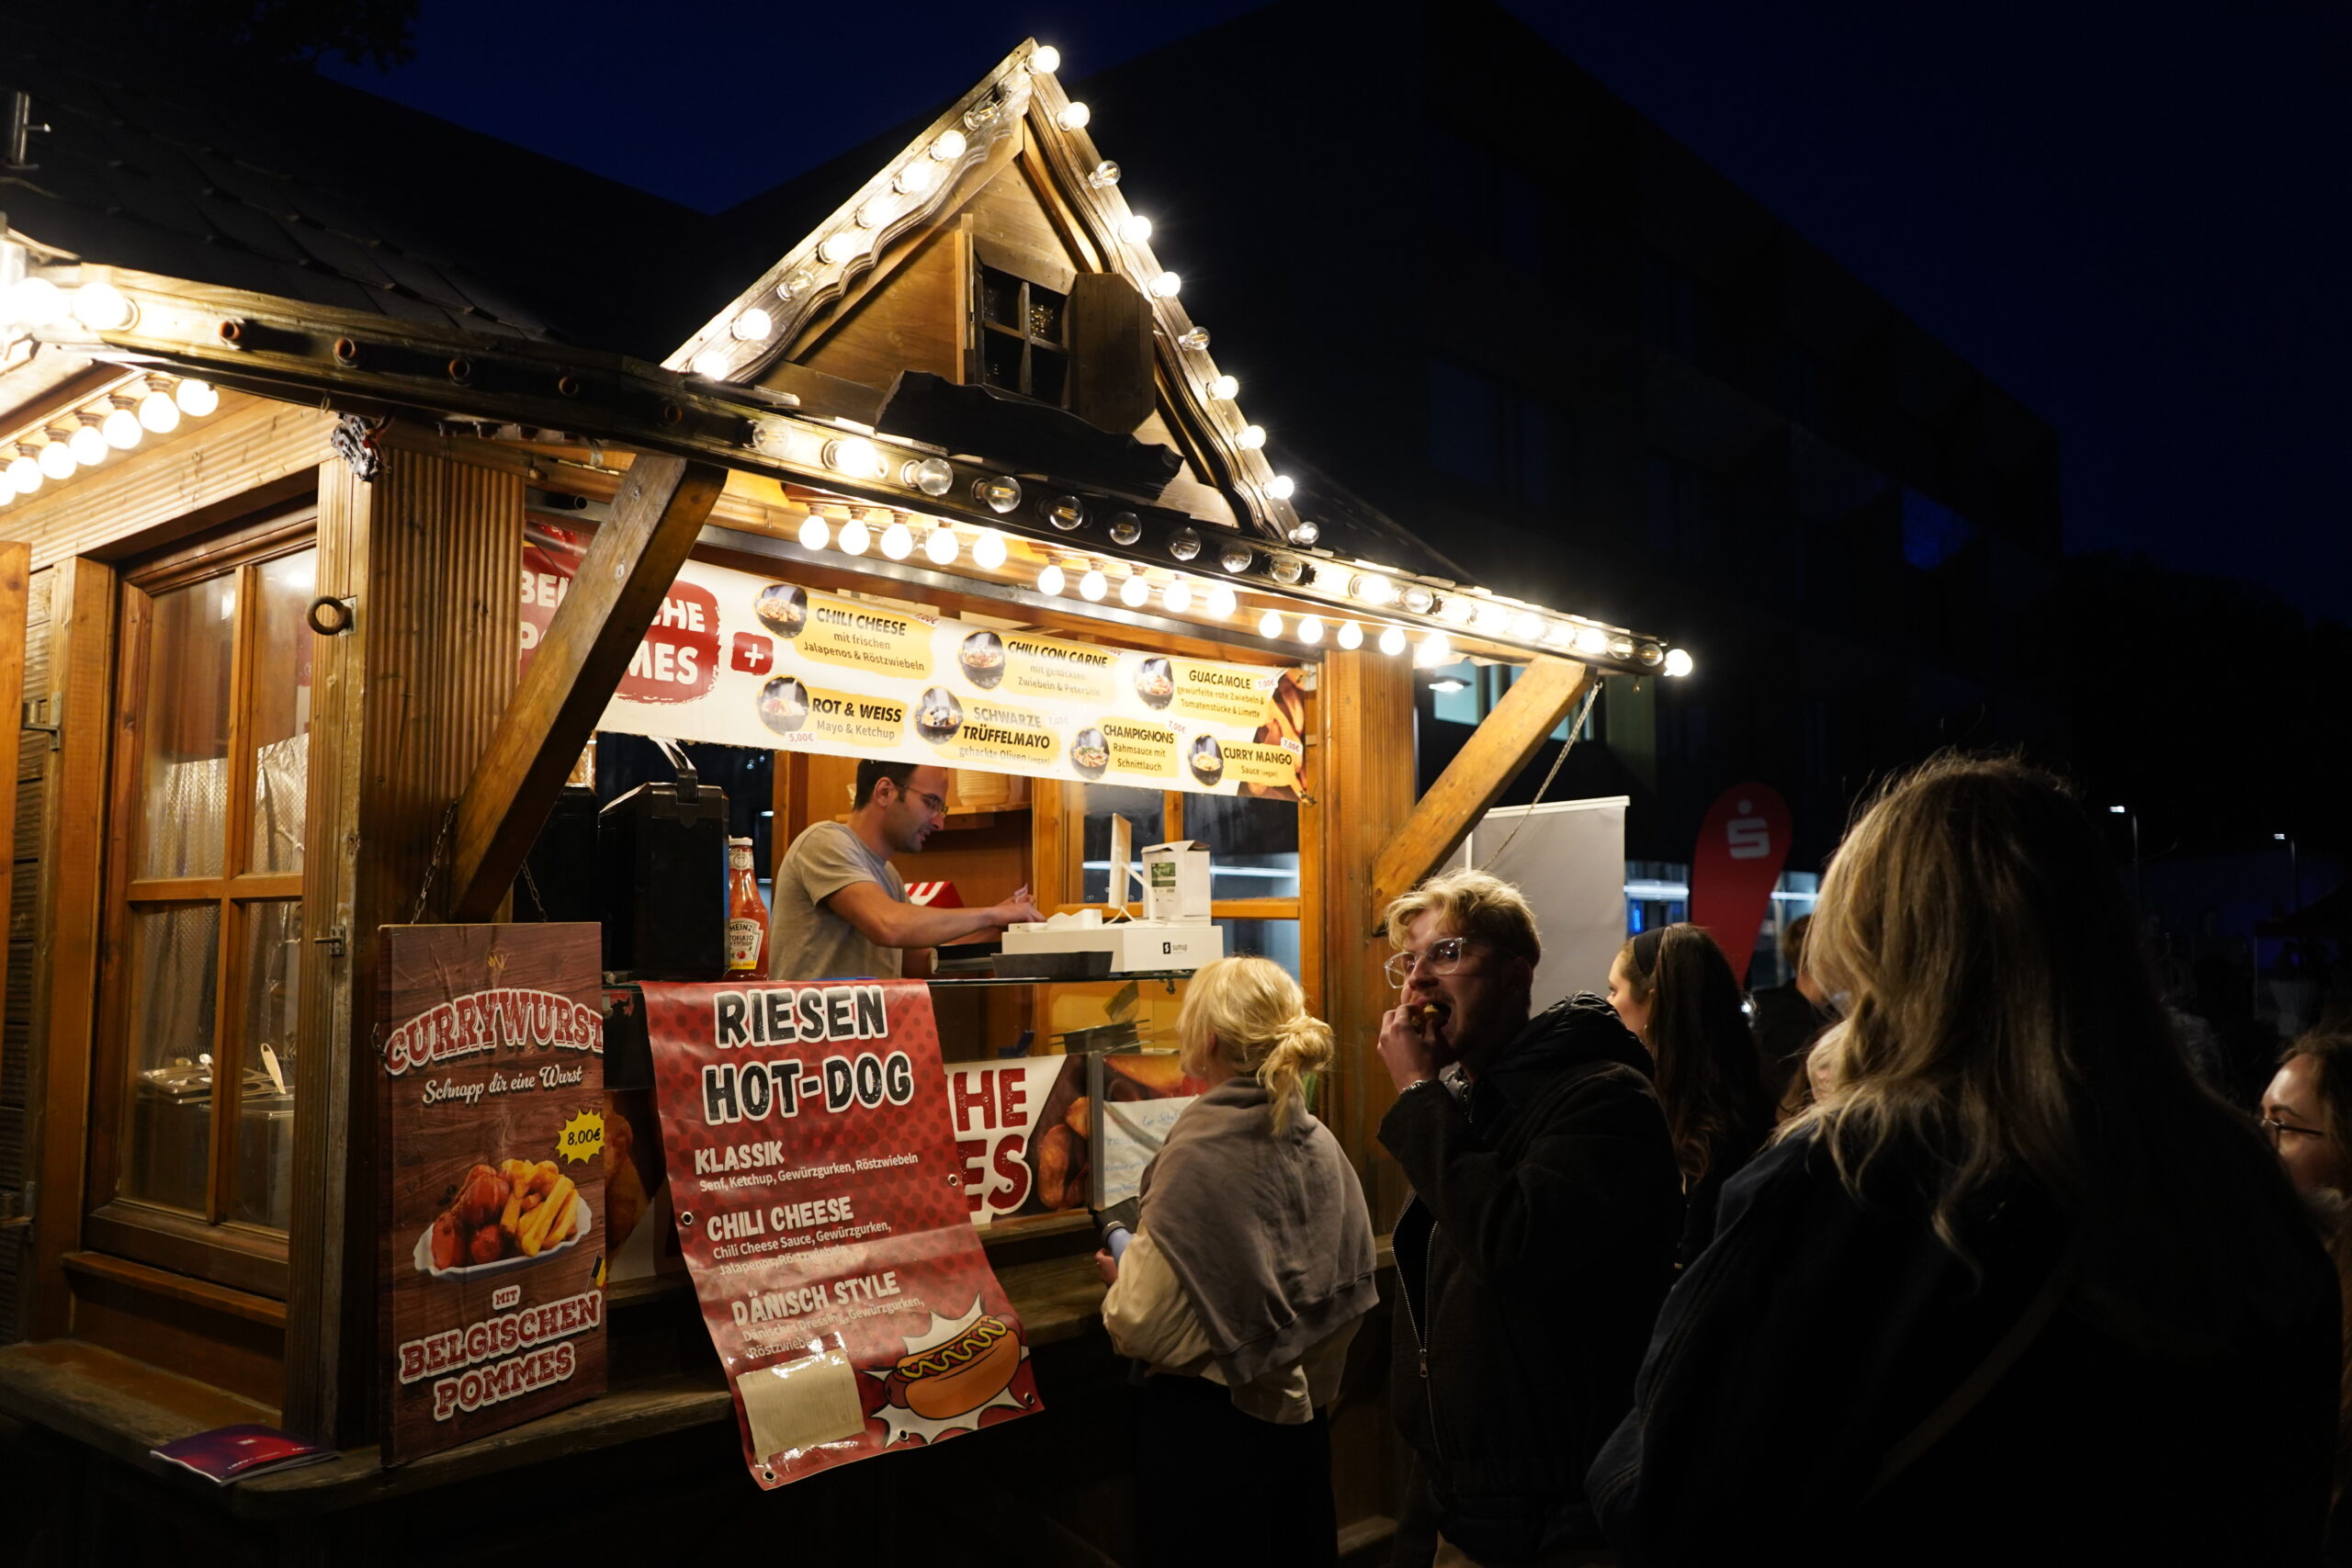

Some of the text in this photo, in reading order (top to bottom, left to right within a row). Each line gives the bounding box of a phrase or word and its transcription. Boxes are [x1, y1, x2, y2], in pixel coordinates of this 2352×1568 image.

[816, 608, 907, 636] CHILI CHEESE
[833, 632, 891, 650] mit frischen
[803, 641, 925, 671] Jalapenos & Röstzwiebeln
[1008, 641, 1039, 658] CHILI
[1040, 647, 1068, 661] CON
[1069, 649, 1108, 669] CARNE
[1030, 664, 1045, 674] mit
[1189, 670, 1251, 690] GUACAMOLE
[1018, 675, 1056, 691] Zwiebeln
[1181, 698, 1232, 714] Tomatenstücke
[1238, 707, 1261, 718] Limette
[1229, 691, 1259, 705] Zwiebeln
[812, 697, 902, 723] ROT & WEISS
[973, 705, 1042, 728] SCHWARZE
[788, 732, 814, 743] 5,00€
[817, 719, 895, 740] Mayo & Ketchup
[963, 723, 1051, 750] TRÜFFELMAYO
[1103, 724, 1174, 744] CHAMPIGNONS
[958, 744, 999, 759] gehackte
[1000, 749, 1027, 762] Oliven
[1113, 742, 1166, 758] Rahmsauce mit
[1223, 747, 1293, 765] CURRY MANGO
[1117, 758, 1162, 772] Schnittlauch
[1240, 765, 1261, 775] Sauce
[713, 985, 888, 1049] RIESEN
[423, 1064, 582, 1104] Schnapp dir eine Wurst
[702, 1051, 914, 1125] HOT-DOG
[567, 1128, 601, 1146] 8,00€
[695, 1140, 786, 1175] KLASSIK
[699, 1152, 919, 1192] Senf, Ketchup, Gewürzgurken, Röstzwiebeln
[707, 1196, 854, 1242] CHILI CHEESE
[712, 1221, 892, 1260] Chili Cheese Sauce, Gewürzgurken,
[493, 1287, 519, 1307] MIT
[731, 1271, 901, 1326] DÄNISCH STYLE
[741, 1323, 799, 1342] Dänisches
[848, 1296, 925, 1321] Gewürzgurken,
[401, 1292, 600, 1382] BELGISCHEN
[435, 1343, 574, 1419] POMMES
